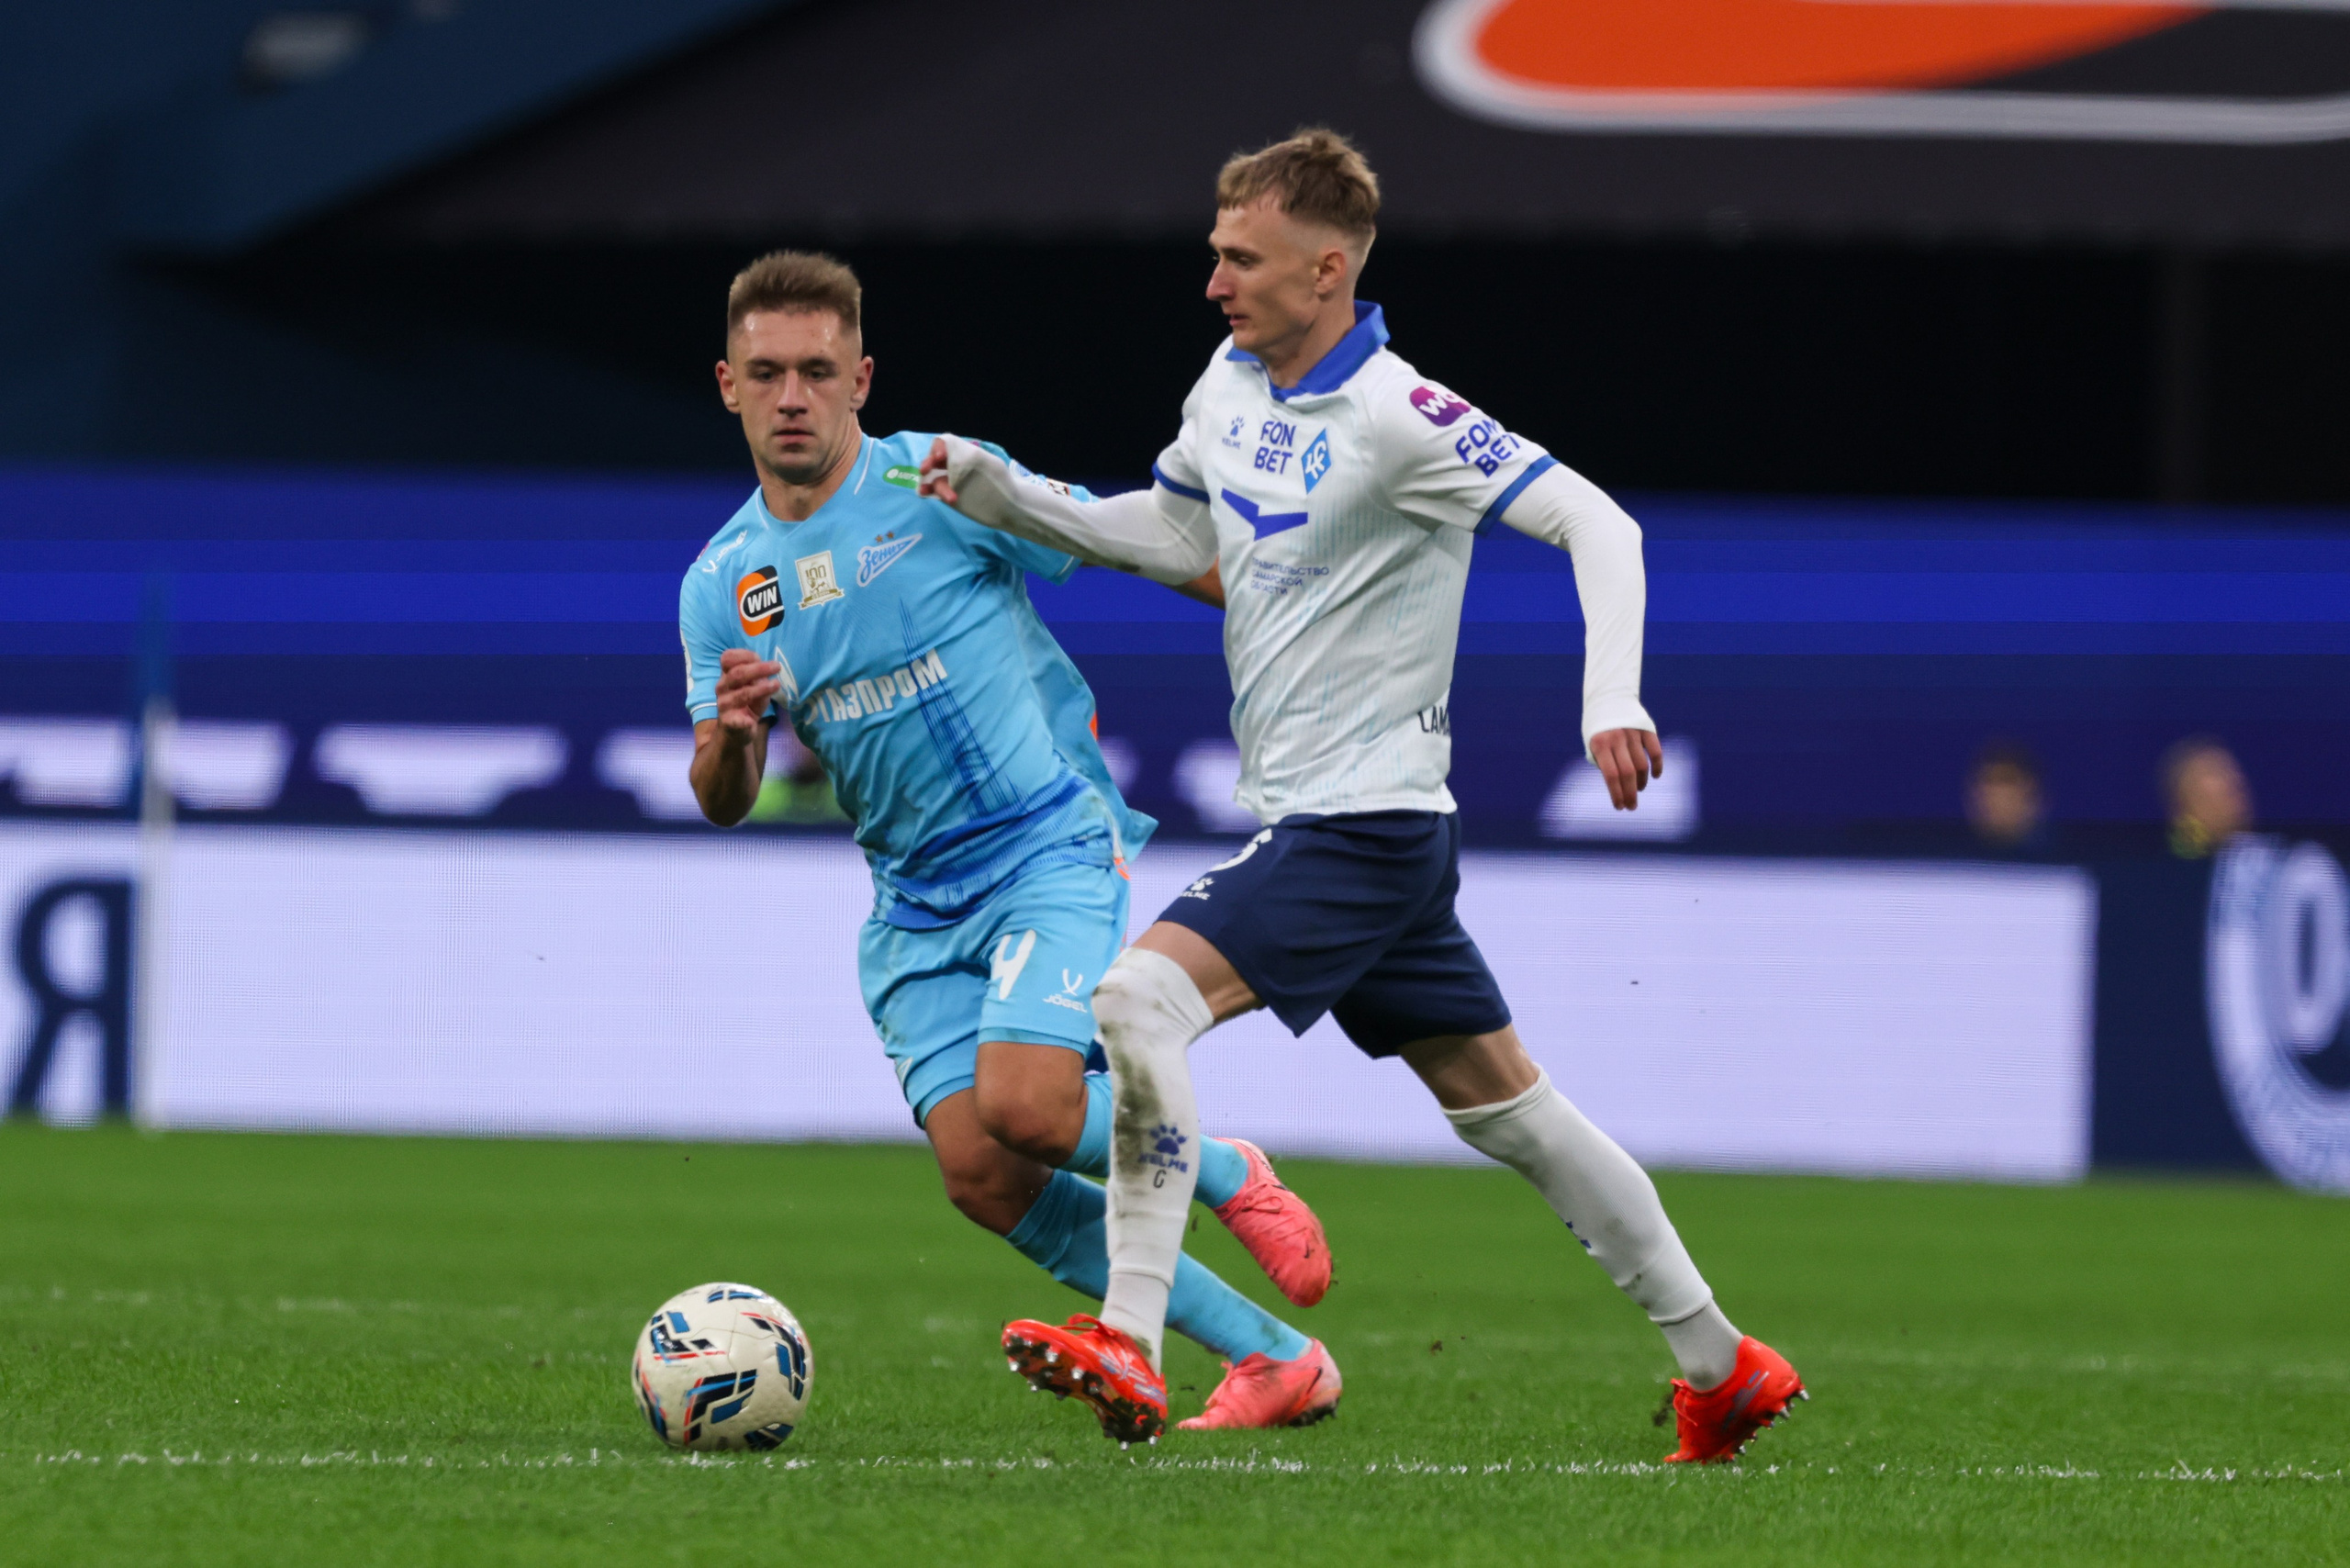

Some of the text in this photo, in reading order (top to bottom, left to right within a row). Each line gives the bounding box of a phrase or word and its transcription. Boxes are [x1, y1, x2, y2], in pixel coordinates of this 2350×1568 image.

[1221, 436, 1241, 450] KELME
[1259, 420, 1297, 447] FON
[1455, 418, 1500, 465] FON
[1254, 446, 1293, 475] BET
[1474, 433, 1520, 478] BET
[805, 565, 827, 579] 100
[1252, 556, 1330, 577] ПРАВИТЕЛЬСТВО
[747, 586, 778, 614] WIN
[1180, 890, 1211, 901] ELME
[990, 928, 1036, 1001] 4
[1137, 1152, 1189, 1173] KELME
